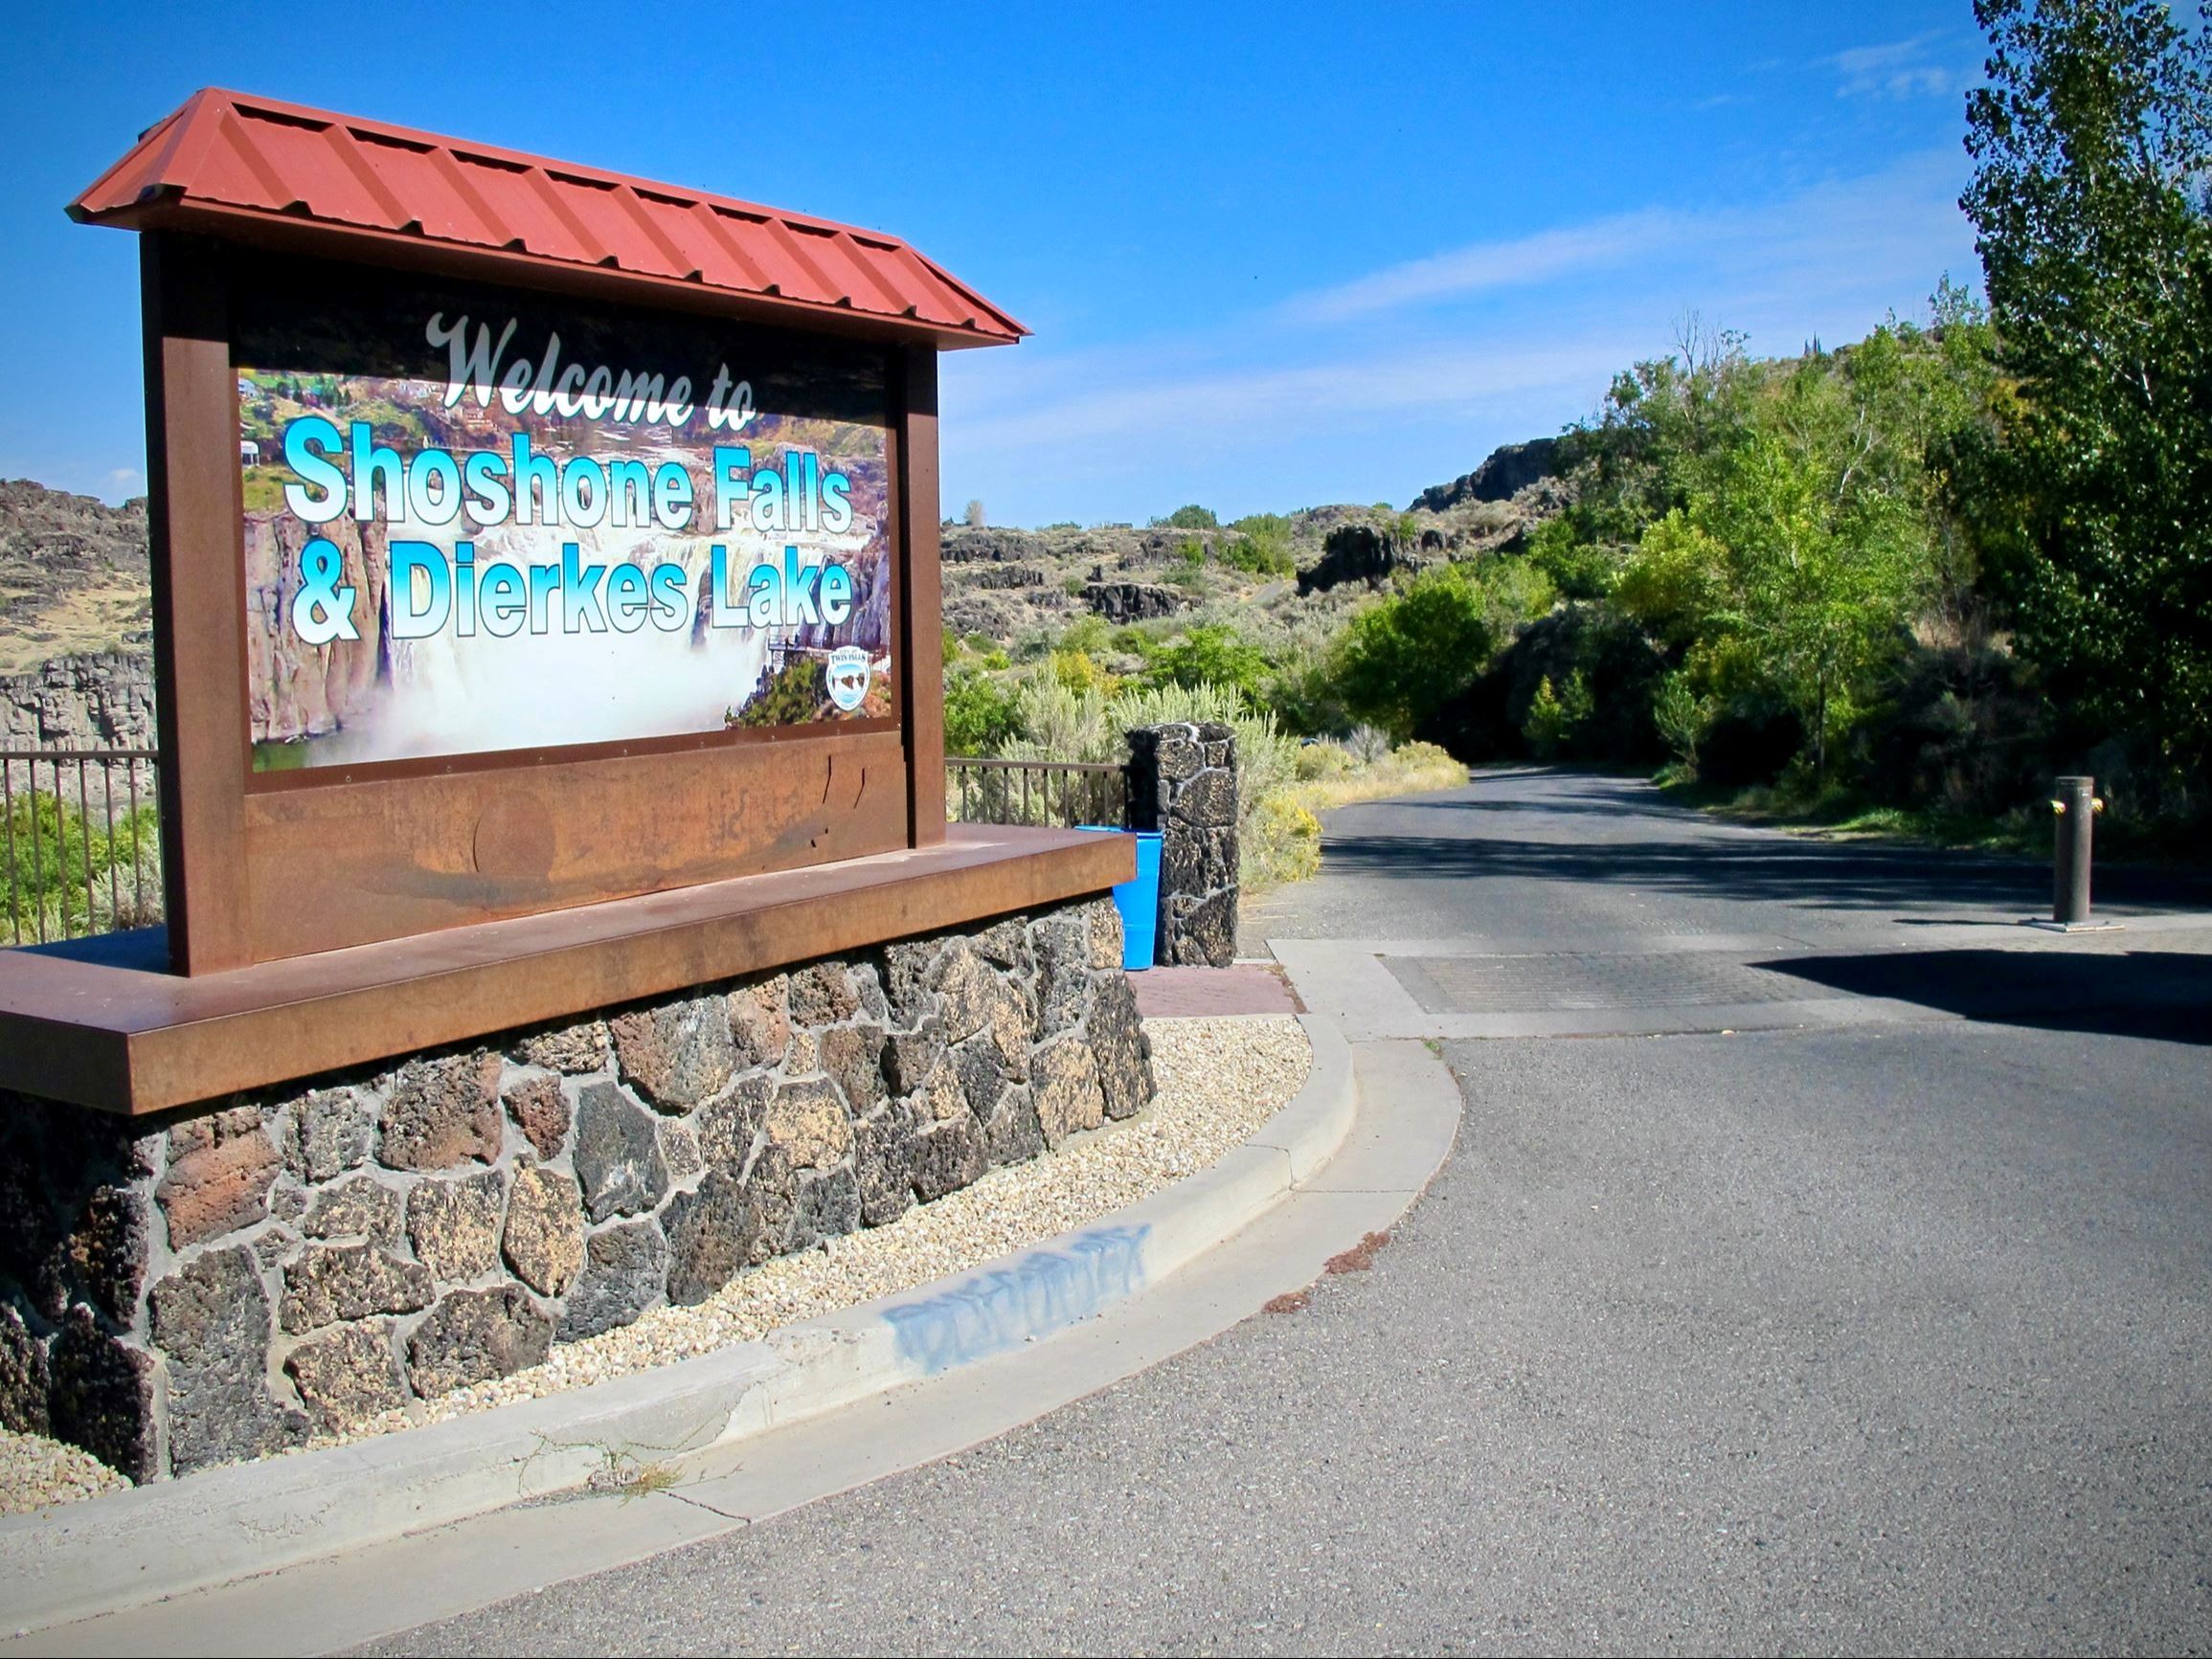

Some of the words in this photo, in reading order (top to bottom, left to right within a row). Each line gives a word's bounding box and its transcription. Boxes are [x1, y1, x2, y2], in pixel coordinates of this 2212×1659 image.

[425, 311, 695, 425] Welcome
[704, 363, 756, 431] to
[283, 415, 694, 528] Shoshone
[712, 445, 853, 533] Falls
[292, 538, 361, 645] &
[390, 540, 688, 639] Dierkes
[711, 544, 853, 629] Lake
[830, 654, 847, 664] TWIN
[848, 653, 867, 662] FALLS
